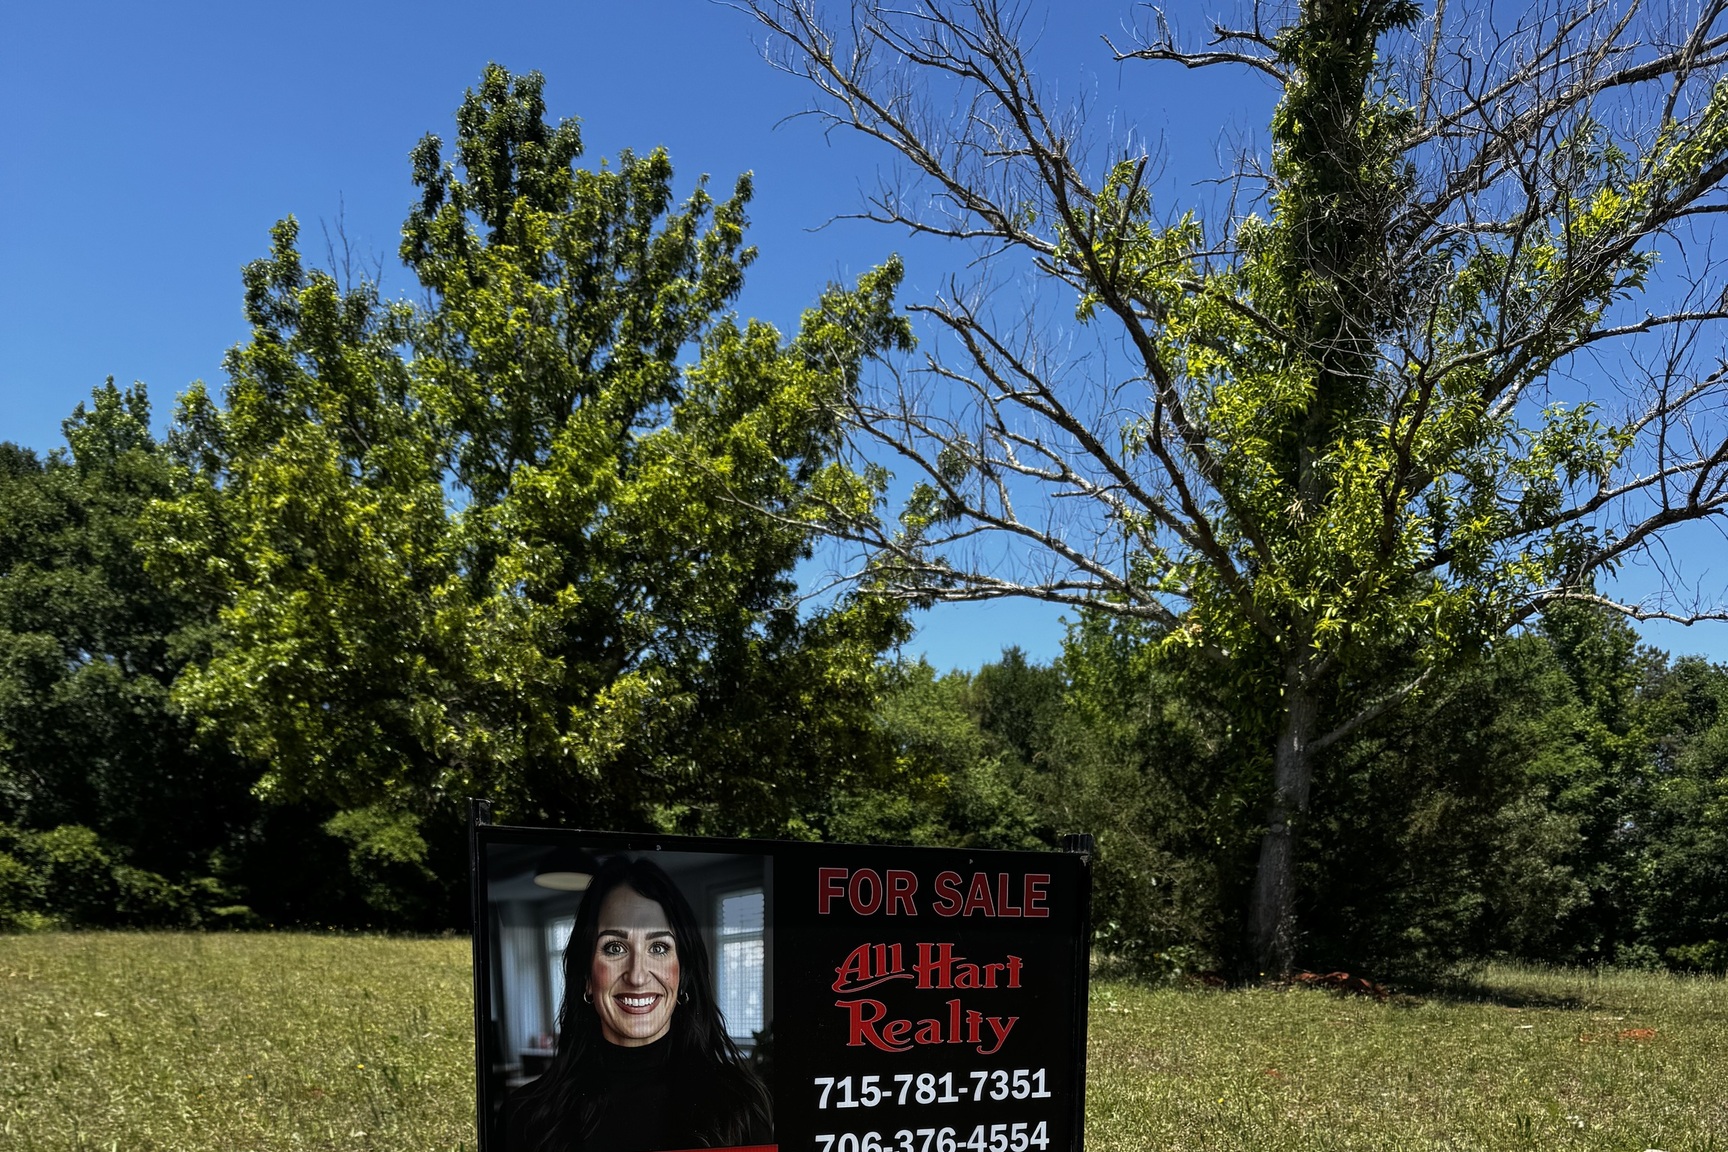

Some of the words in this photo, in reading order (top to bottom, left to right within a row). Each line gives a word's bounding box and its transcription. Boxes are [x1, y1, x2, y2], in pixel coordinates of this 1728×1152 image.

[818, 867, 918, 917] FOR
[933, 871, 1051, 918] SALE
[832, 942, 914, 993] All
[911, 942, 1024, 990] Hart
[835, 999, 1020, 1055] Realty
[814, 1068, 1051, 1109] 715-781-7351
